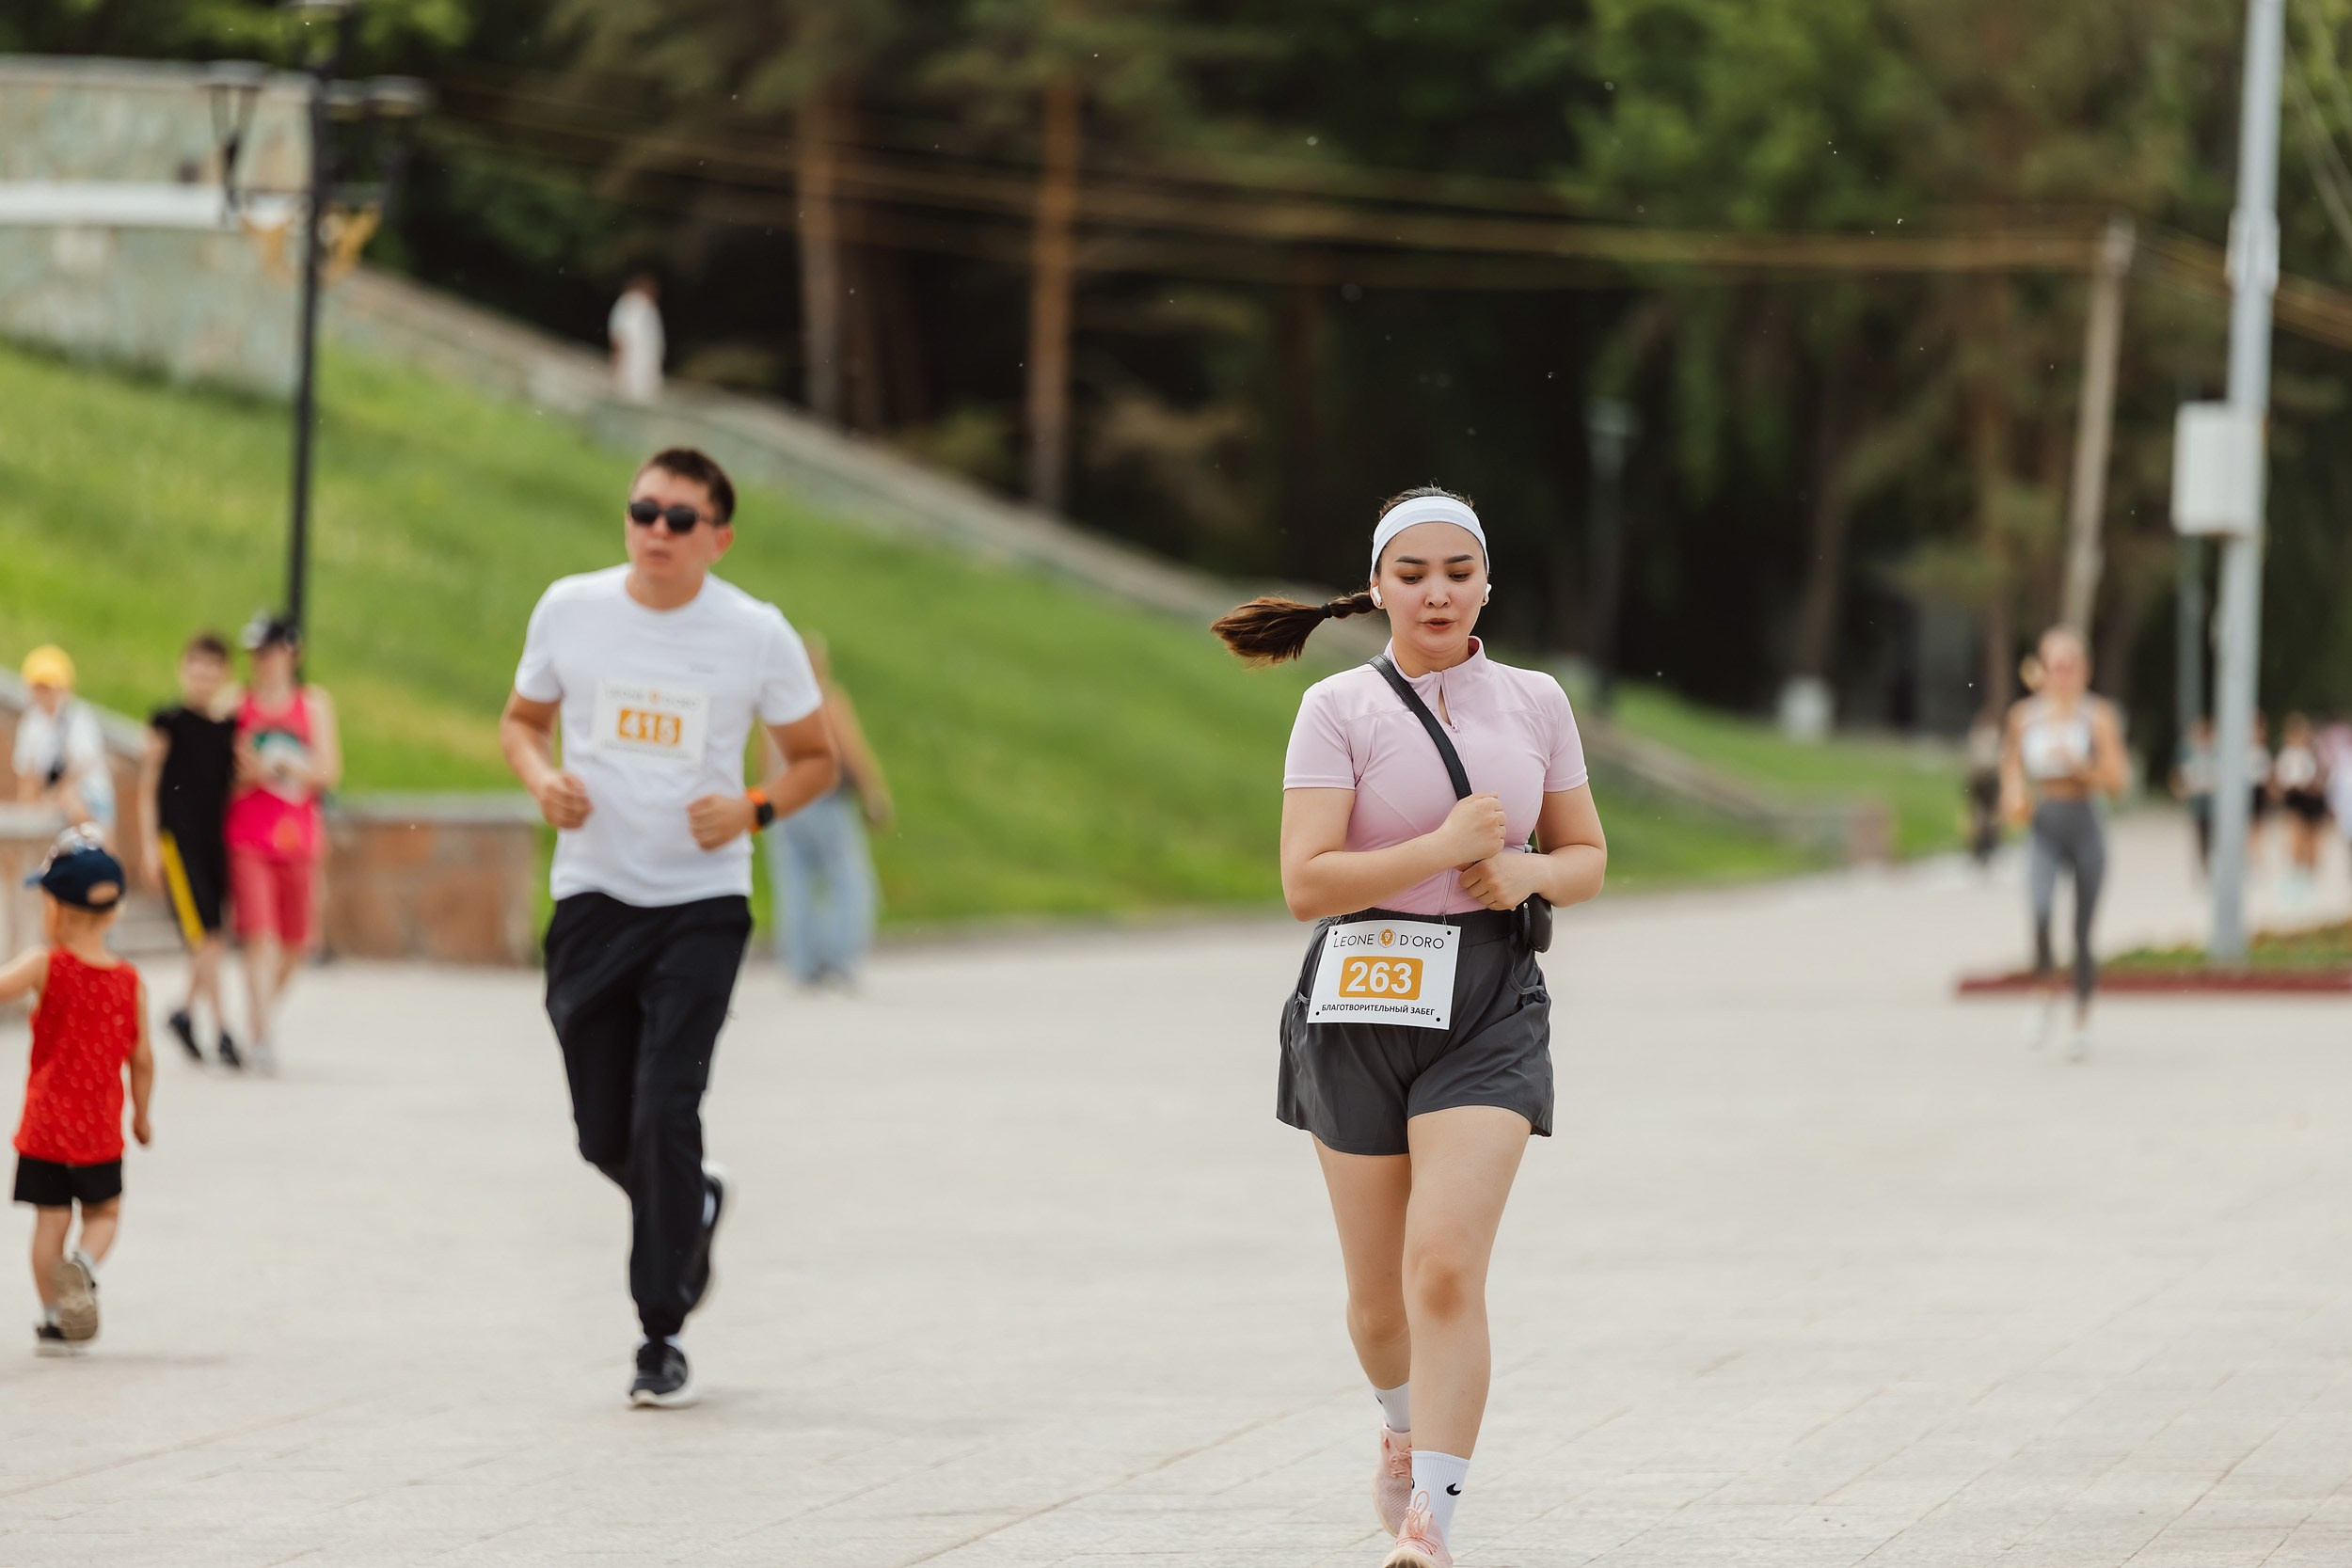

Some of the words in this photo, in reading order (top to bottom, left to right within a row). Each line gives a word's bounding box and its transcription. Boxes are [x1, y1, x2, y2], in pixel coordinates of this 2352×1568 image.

[1333, 933, 1375, 948] LEONE
[1399, 934, 1444, 950] D'ORO
[1346, 961, 1412, 994] 263
[1321, 1004, 1409, 1014] БЛАГОТВОРИТЕЛЬНЫЙ
[1410, 1006, 1435, 1016] ЗАБЕГ
